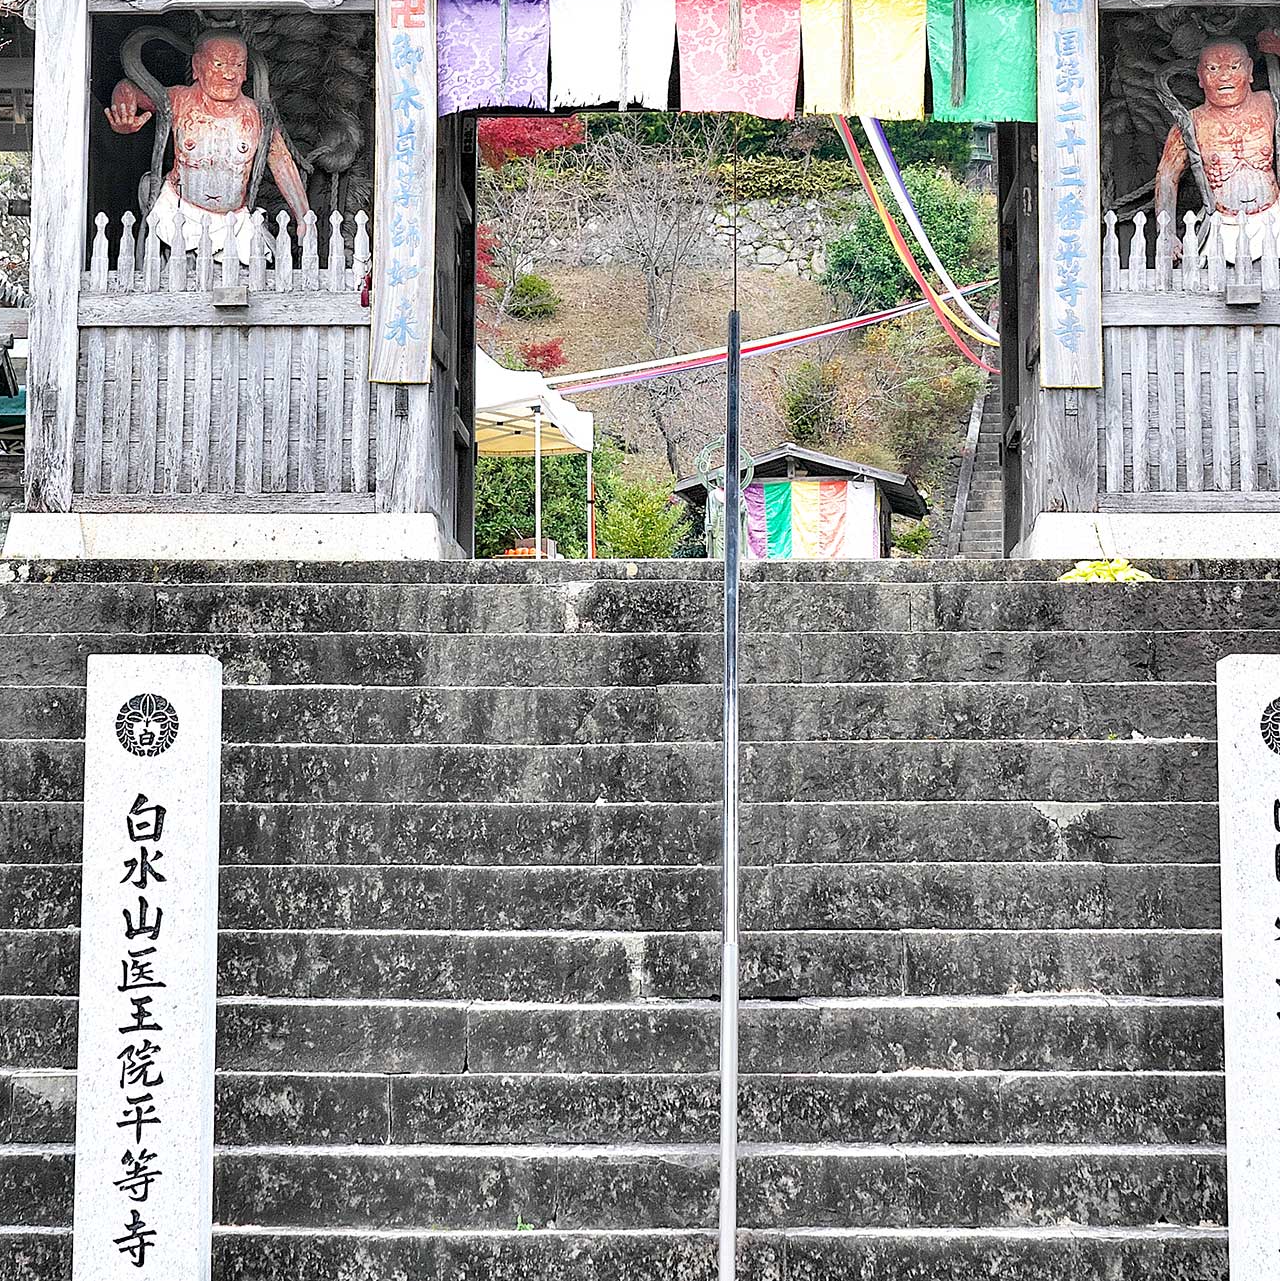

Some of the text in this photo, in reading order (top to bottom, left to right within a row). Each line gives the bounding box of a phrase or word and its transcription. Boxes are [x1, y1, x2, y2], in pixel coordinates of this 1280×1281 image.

[112, 793, 167, 1268] 白水山医王院平等寺
